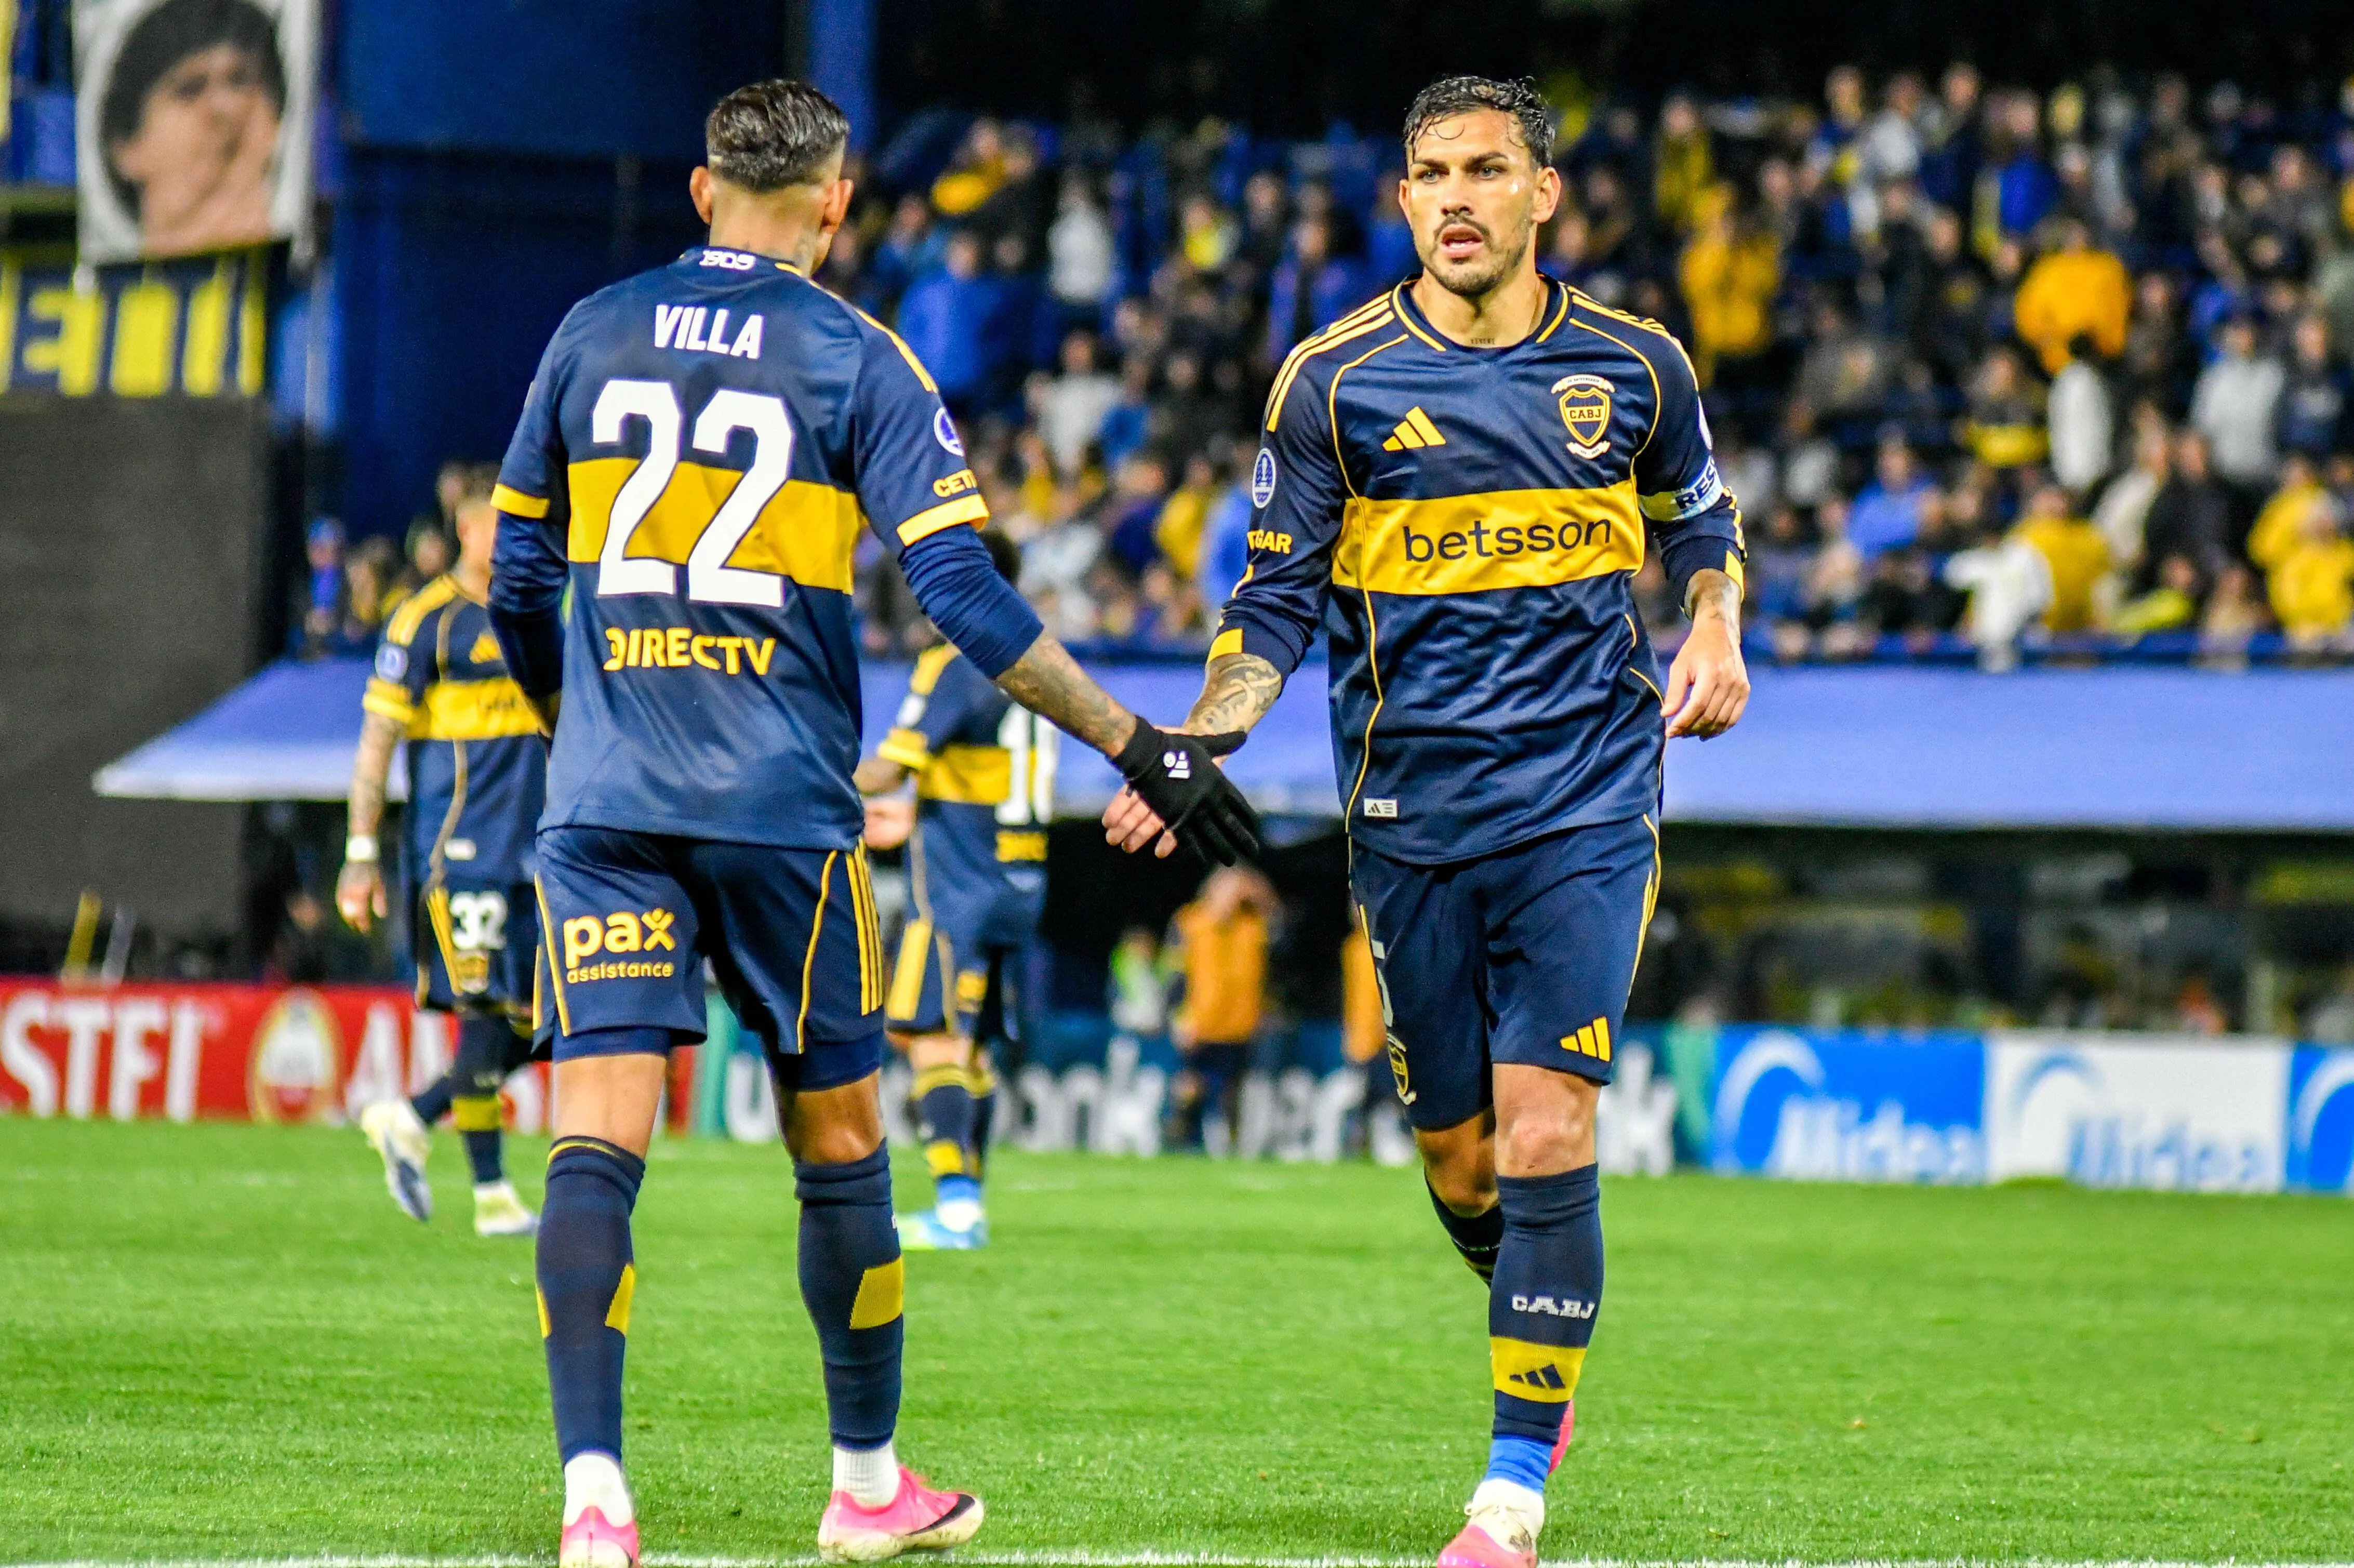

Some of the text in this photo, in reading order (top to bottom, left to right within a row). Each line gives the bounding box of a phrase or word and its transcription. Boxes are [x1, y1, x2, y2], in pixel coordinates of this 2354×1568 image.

[655, 304, 766, 360] VILLA
[1570, 409, 1601, 419] CABJ
[592, 380, 793, 607] 22
[1403, 519, 1611, 563] betsson
[603, 627, 776, 675] DIRECTV
[450, 891, 508, 950] 32
[564, 908, 675, 969] pax
[567, 962, 674, 984] assistance
[1512, 1296, 1595, 1320] CABJ
